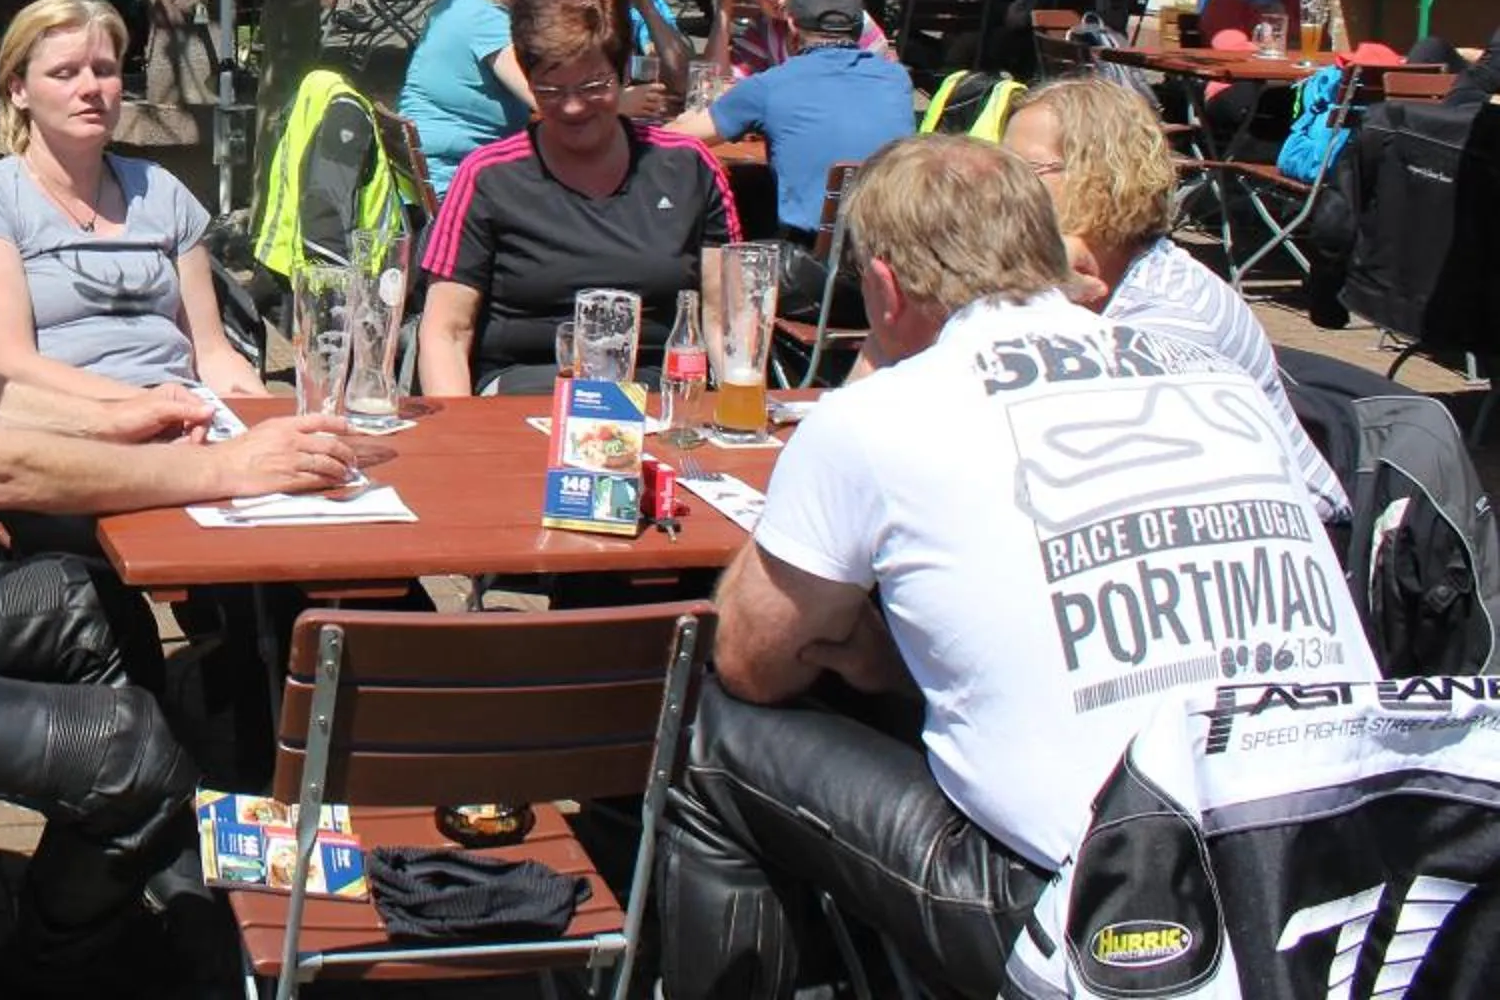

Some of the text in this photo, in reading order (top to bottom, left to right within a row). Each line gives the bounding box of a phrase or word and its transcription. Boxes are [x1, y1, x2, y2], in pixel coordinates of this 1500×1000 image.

[1047, 500, 1309, 580] RACE OF PORTUGAL
[1192, 682, 1353, 755] FAST
[1240, 725, 1299, 752] SPEED
